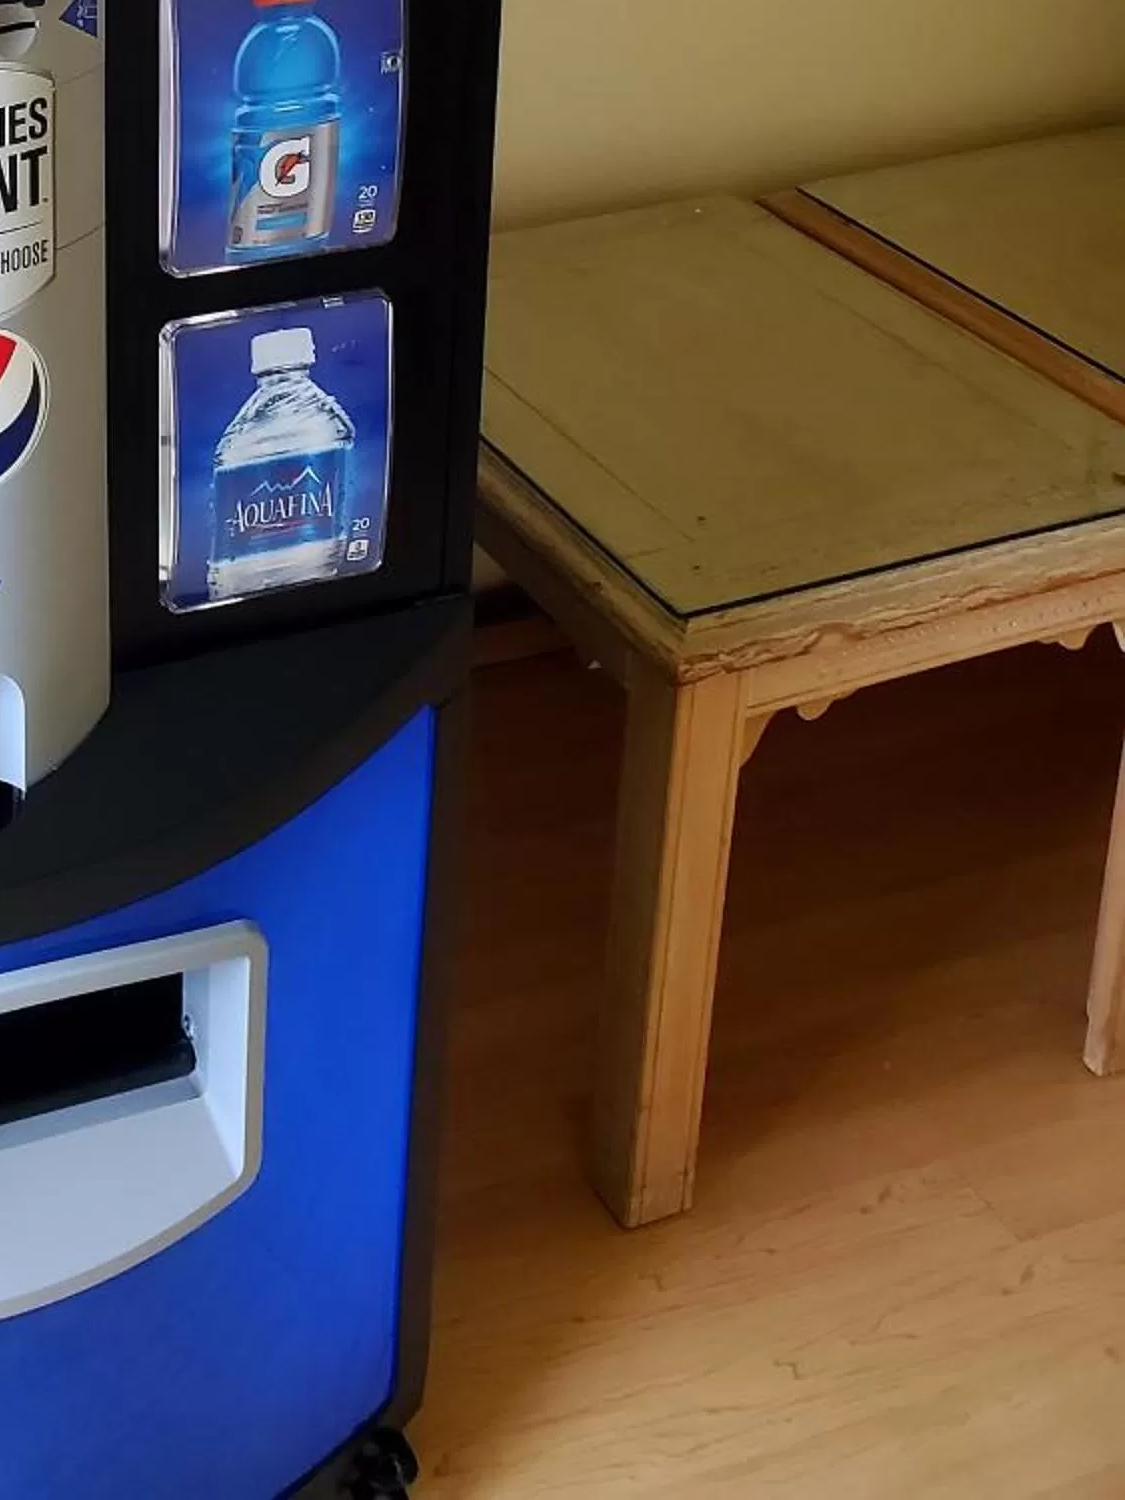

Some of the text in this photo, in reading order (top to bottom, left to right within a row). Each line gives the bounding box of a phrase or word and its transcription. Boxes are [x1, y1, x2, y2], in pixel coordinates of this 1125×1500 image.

[358, 185, 378, 200] 20
[227, 481, 333, 533] AQUAFINA
[352, 517, 370, 531] 20
